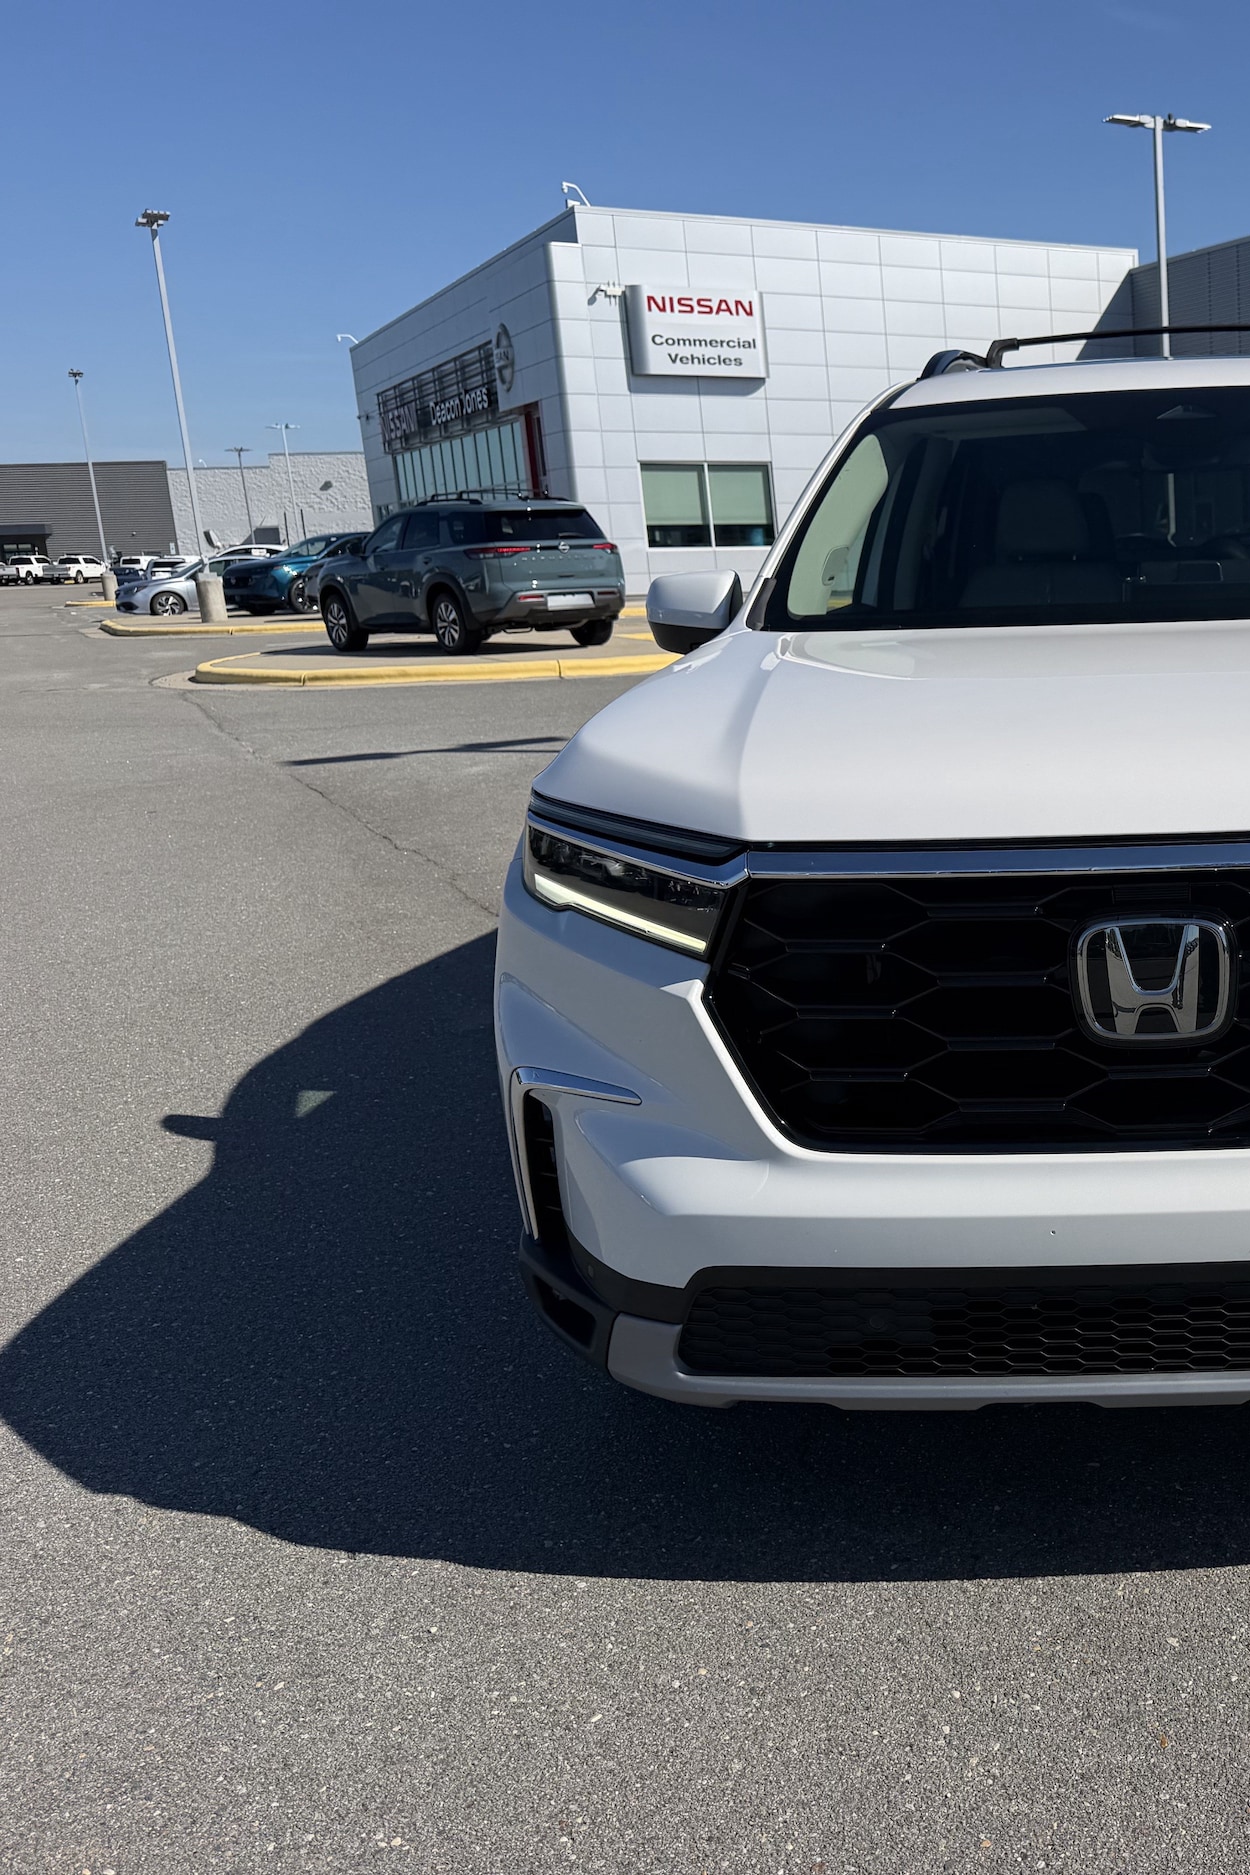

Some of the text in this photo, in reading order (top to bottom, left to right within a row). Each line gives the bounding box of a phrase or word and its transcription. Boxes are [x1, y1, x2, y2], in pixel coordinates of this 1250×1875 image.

[646, 295, 754, 317] NISSAN
[651, 334, 757, 350] Commercial
[667, 352, 743, 367] Vehicles
[429, 386, 489, 426] Deacon Jones
[381, 401, 418, 441] NISSAN
